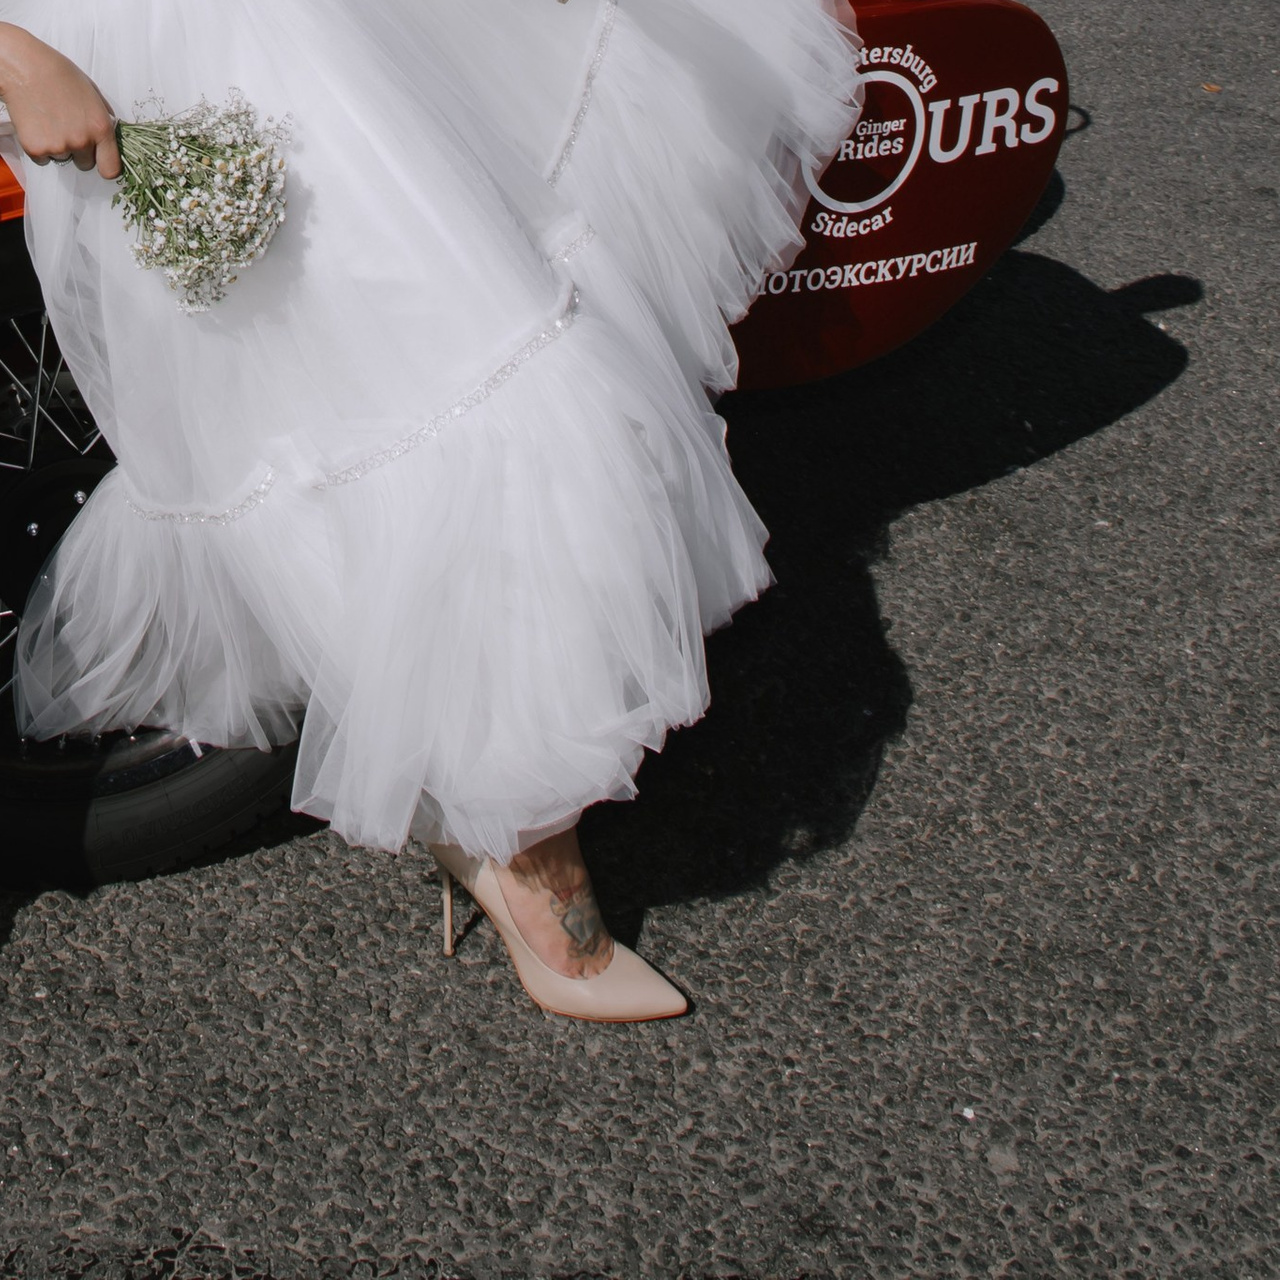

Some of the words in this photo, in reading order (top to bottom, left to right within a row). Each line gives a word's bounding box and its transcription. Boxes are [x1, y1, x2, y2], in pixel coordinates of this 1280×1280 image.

[855, 118, 907, 138] Ginger
[837, 136, 905, 162] Rides
[811, 206, 894, 238] Sidecar
